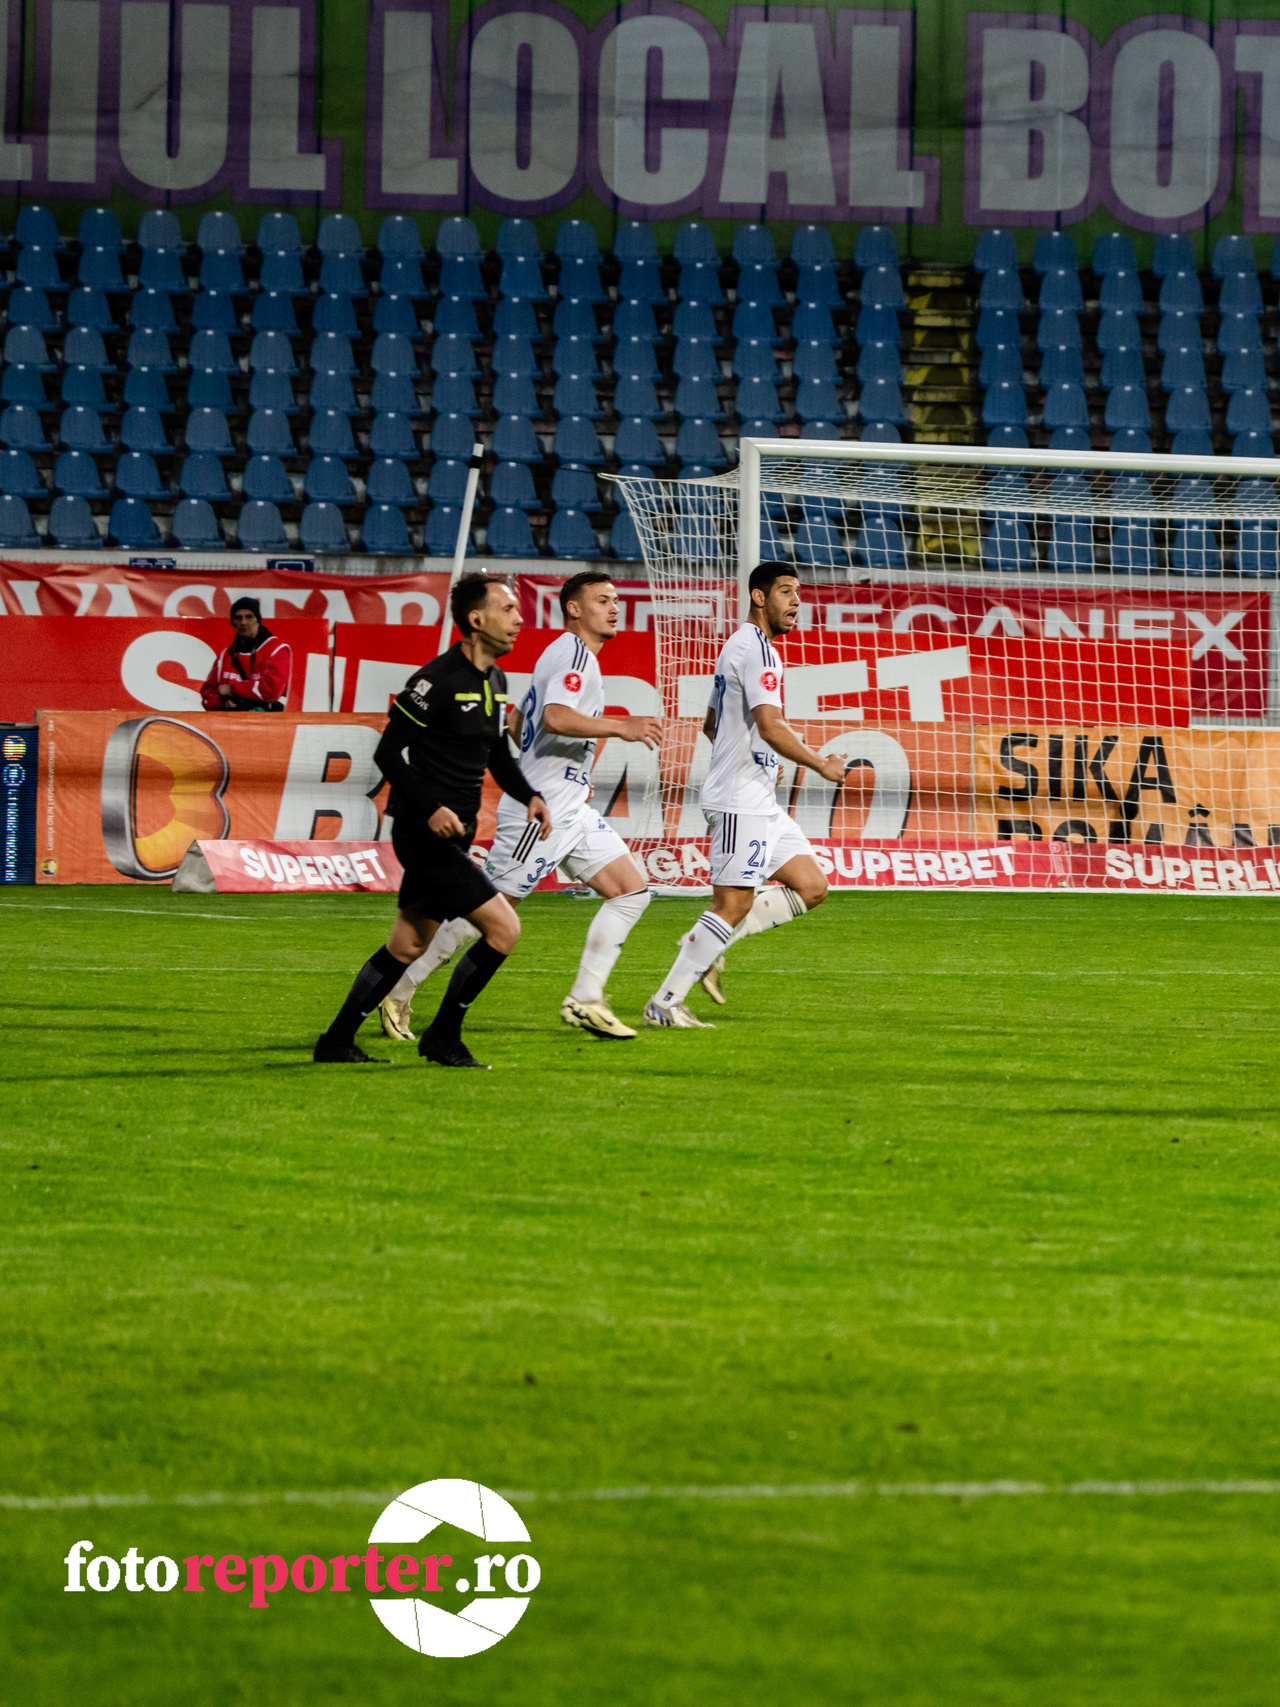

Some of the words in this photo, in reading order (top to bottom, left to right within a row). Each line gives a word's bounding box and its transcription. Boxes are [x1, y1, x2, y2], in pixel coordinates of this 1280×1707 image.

[380, 10, 925, 208] LOCAL
[998, 732, 1176, 804] SIKA
[243, 848, 388, 886] SUPERBET
[813, 845, 1015, 886] SUPERBET
